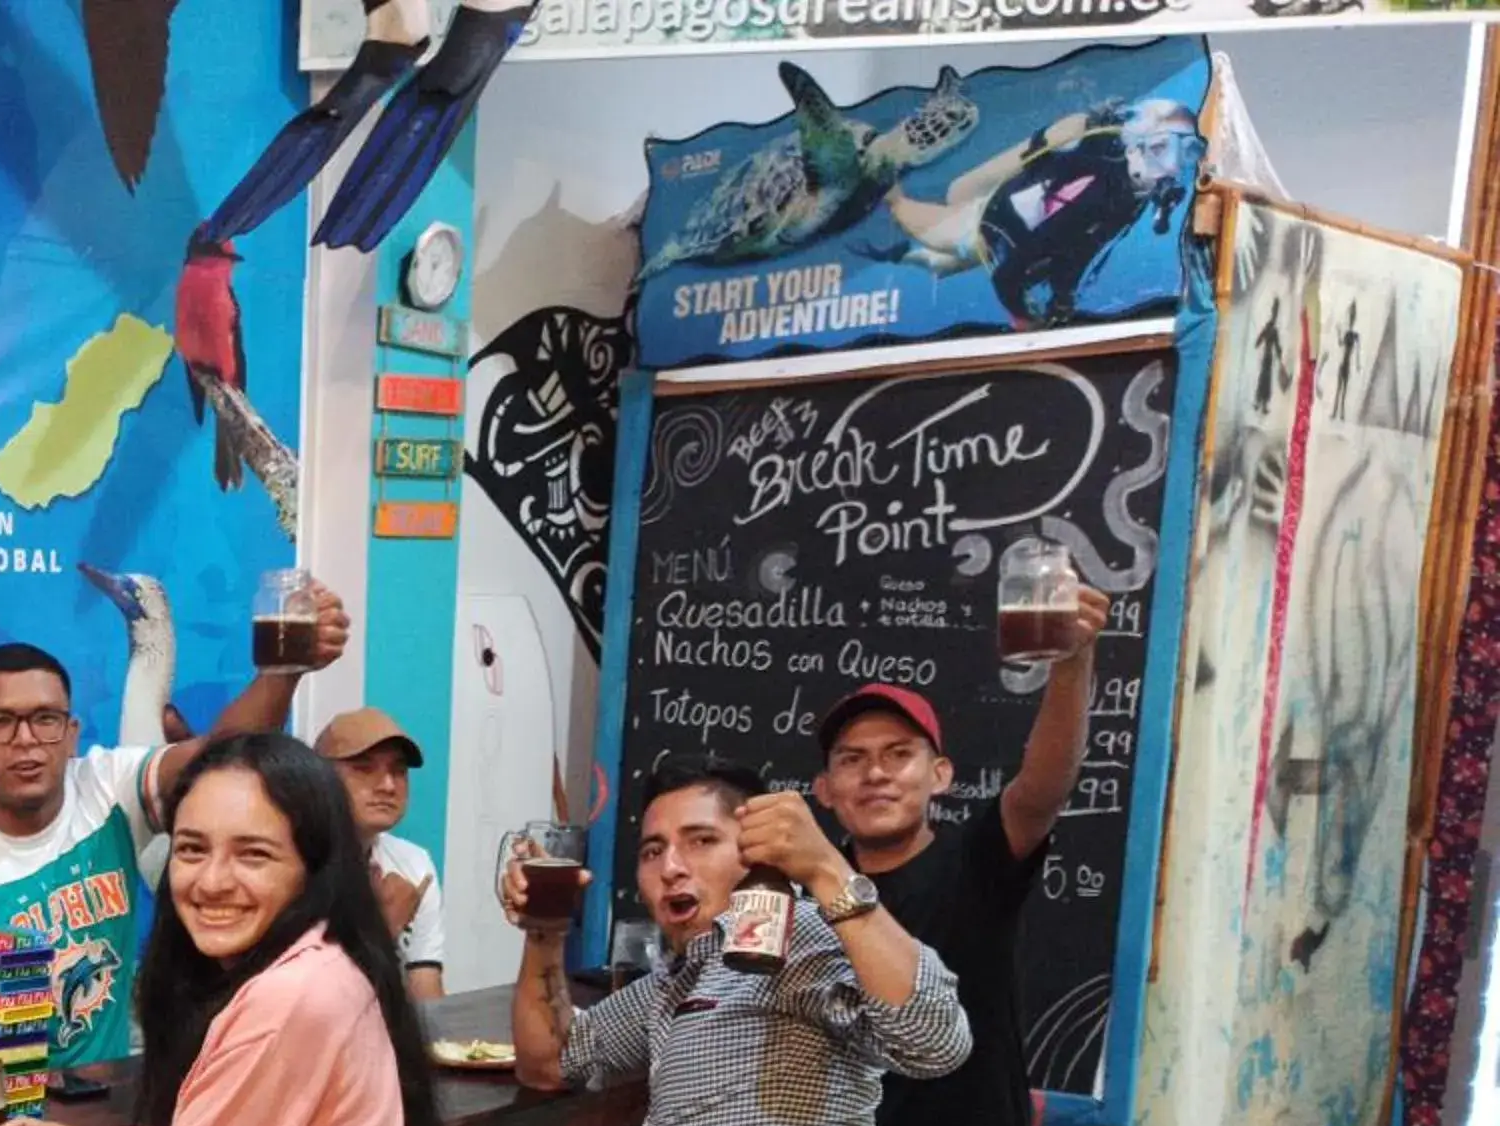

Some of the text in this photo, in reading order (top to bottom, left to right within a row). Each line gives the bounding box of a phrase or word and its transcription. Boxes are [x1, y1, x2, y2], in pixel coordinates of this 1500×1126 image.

[518, 0, 1192, 46] galapagosdreams..
[673, 263, 842, 319] START YOUR
[719, 288, 899, 345] ADVENTURE!
[396, 442, 441, 470] SURF
[887, 383, 1050, 487] Time
[816, 478, 956, 566] Point
[656, 586, 846, 629] Quesadilla
[655, 629, 936, 685] Nachos con Queso
[651, 685, 816, 744] Totopos de
